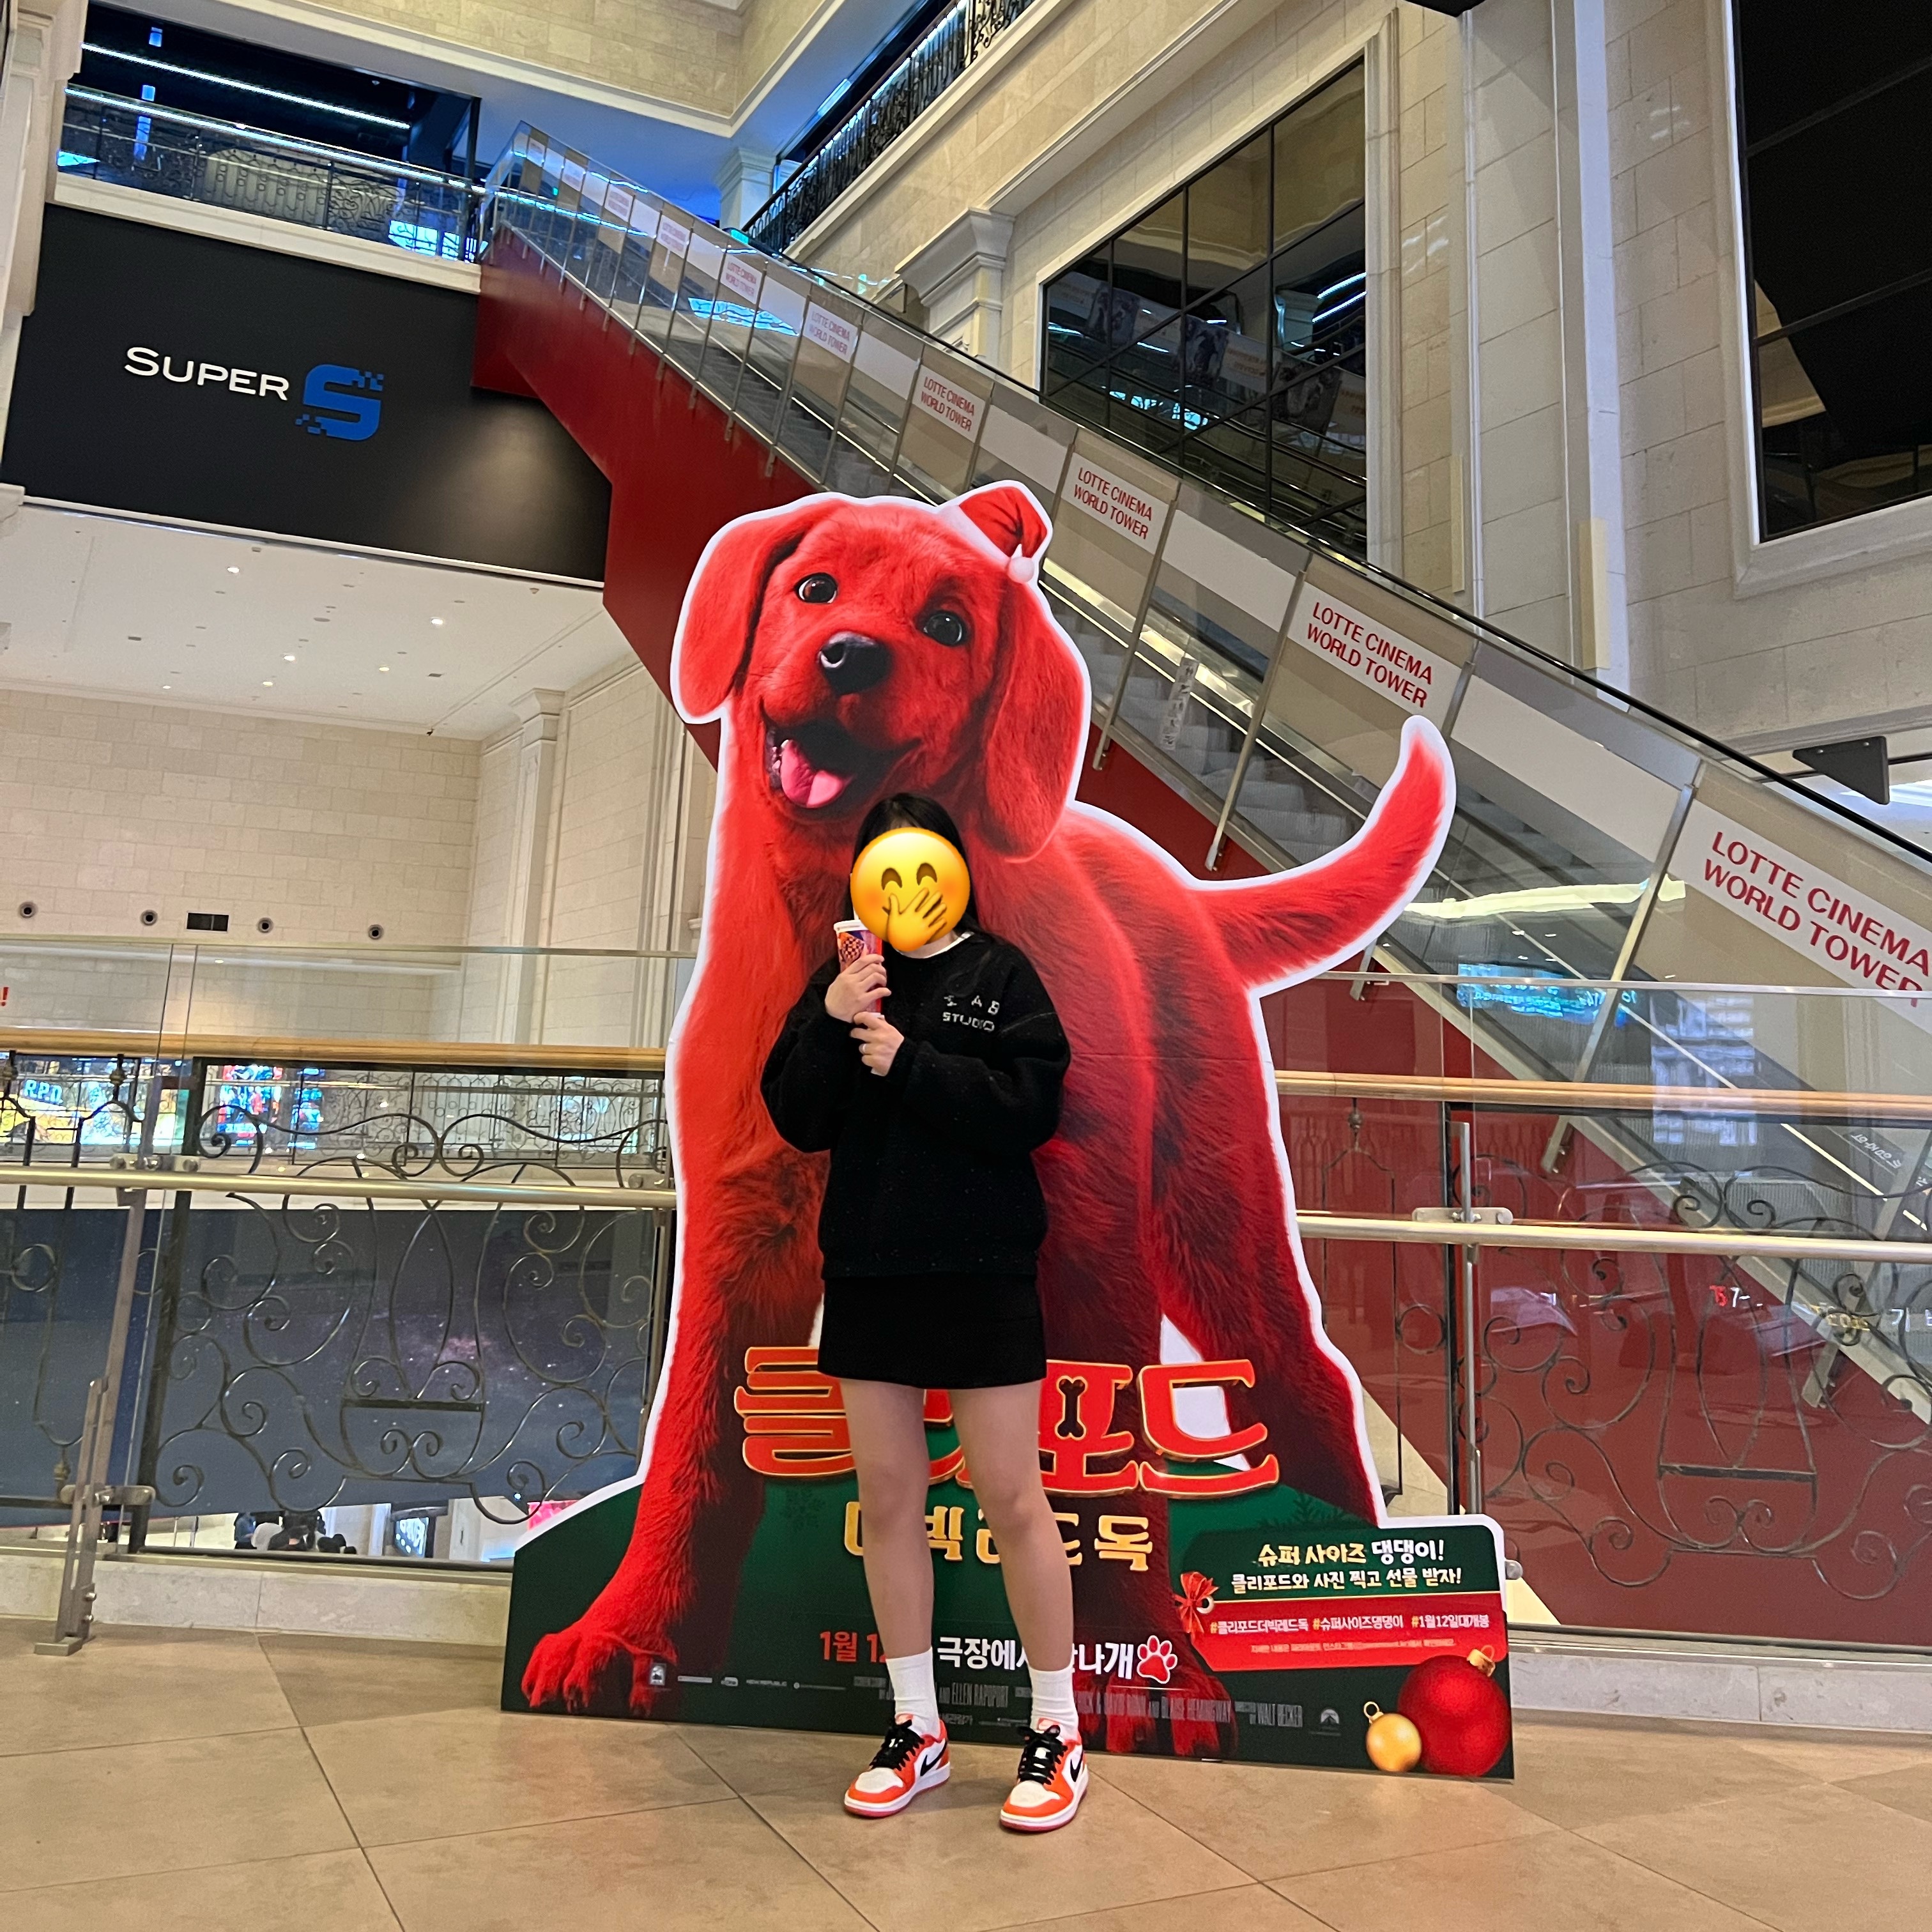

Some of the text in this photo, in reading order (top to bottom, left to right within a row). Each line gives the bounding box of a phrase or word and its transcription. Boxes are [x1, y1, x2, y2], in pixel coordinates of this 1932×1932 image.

[809, 324, 848, 355] WORLD TOWER
[811, 310, 850, 343] LOTTE CINEMA
[124, 346, 289, 401] SUPER
[924, 376, 975, 416] LOTTE CINEMA
[921, 392, 972, 432] WORLD TOWER
[1074, 484, 1149, 540] WORLD TOWER
[1078, 467, 1152, 521] LOTTE CINEMA
[1307, 623, 1427, 708] WORLD TOWER
[1312, 602, 1432, 685] LOTTE CINEMA
[1705, 858, 1800, 931] WORLD
[1712, 831, 1929, 977] LOTTE CINEMA
[942, 1011, 995, 1032] STUDIO
[1094, 1514, 1153, 1572] 독
[1258, 1539, 1444, 1567] 슈퍼 사이즈 댕댕이!
[1231, 1567, 1462, 1594] 클리포드와 사진 찍고 선물 받자!
[820, 1631, 858, 1661] 1월
